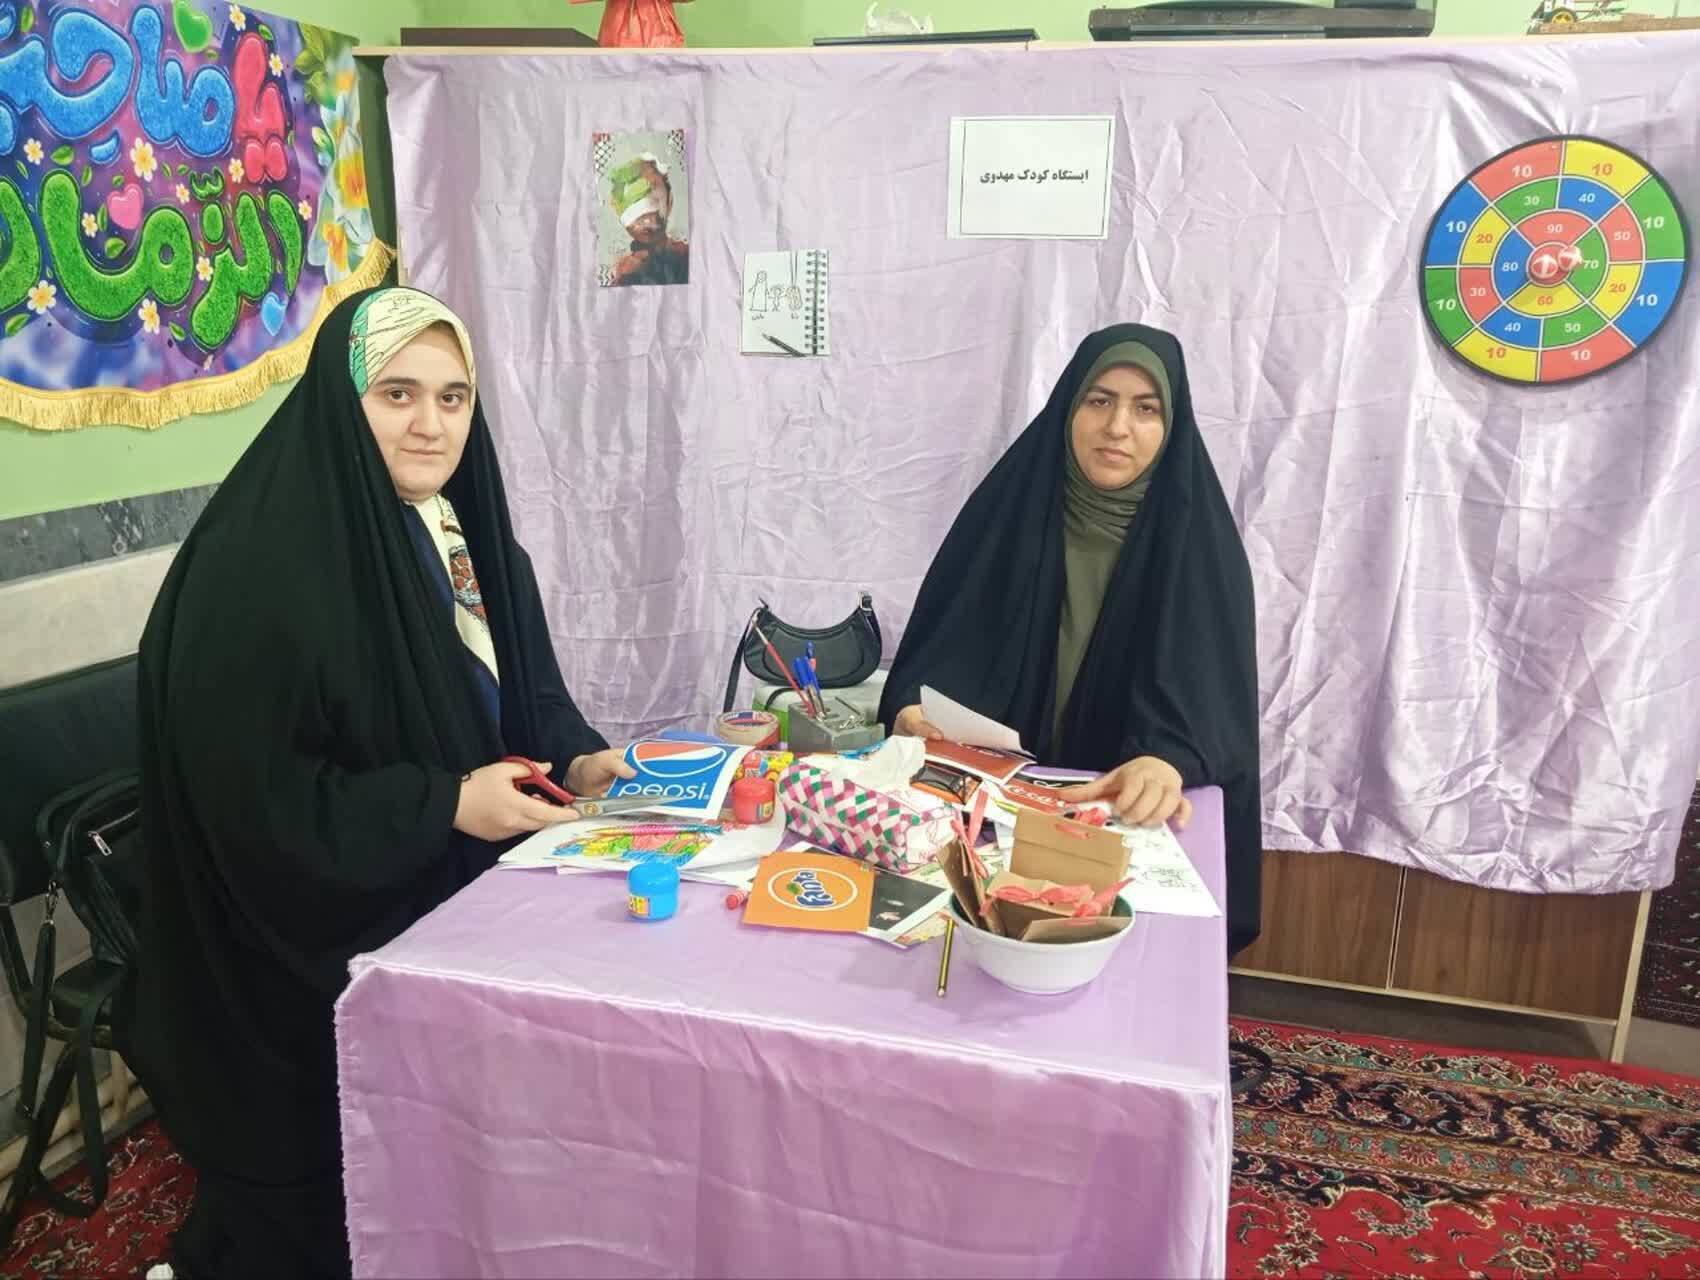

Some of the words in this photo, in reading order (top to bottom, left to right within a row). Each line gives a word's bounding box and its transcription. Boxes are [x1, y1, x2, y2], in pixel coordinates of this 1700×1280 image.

[1512, 165, 1532, 178] 10
[1592, 163, 1612, 176] 10
[980, 171, 1014, 183] مهدوی
[1018, 169, 1049, 183] کودک
[1052, 169, 1088, 183] ایستگاه
[1524, 196, 1540, 206] 30
[1579, 193, 1595, 203] 40
[1446, 221, 1466, 232] 10
[1643, 216, 1664, 228] 10
[1546, 224, 1562, 234] 90
[1476, 234, 1493, 244] 20
[1614, 231, 1631, 241] 50
[1502, 262, 1518, 271] 80
[1583, 260, 1599, 269] 70
[1470, 287, 1485, 297] 30
[1610, 283, 1626, 293] 20
[1436, 299, 1456, 310] 10
[1537, 296, 1553, 306] 60
[1636, 294, 1658, 307] 10
[1505, 323, 1520, 332] 40
[1565, 323, 1580, 333] 50
[1486, 347, 1506, 359] 10
[1571, 350, 1590, 361] 10
